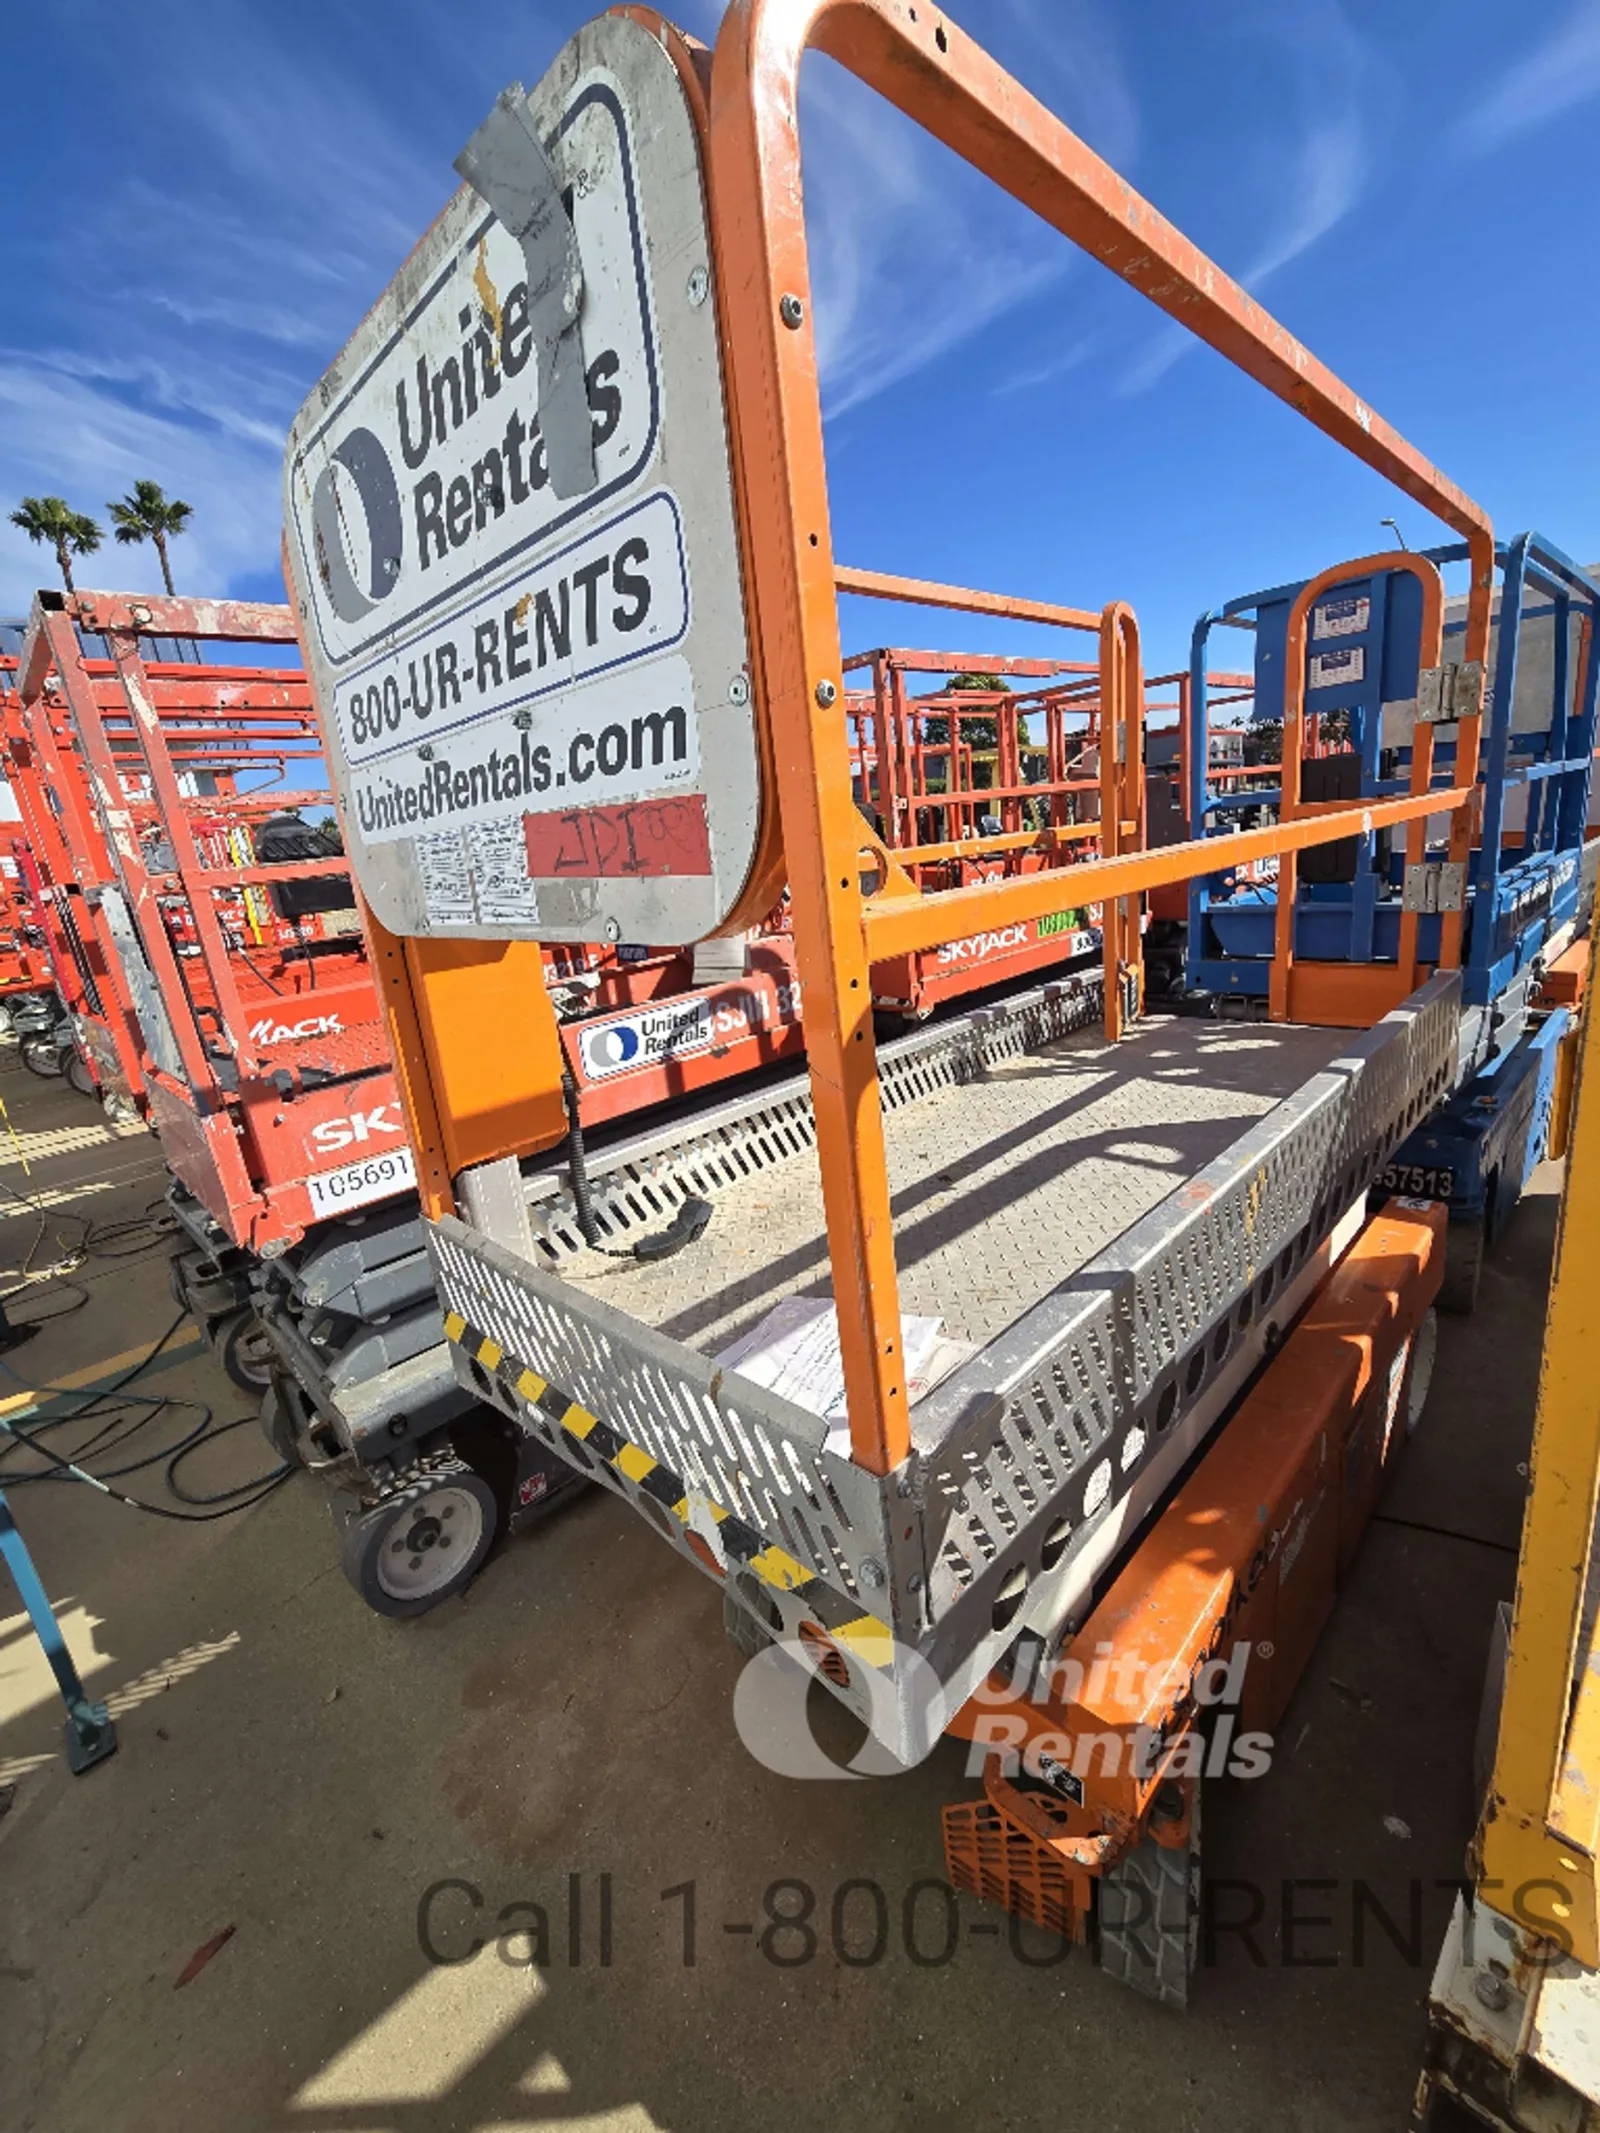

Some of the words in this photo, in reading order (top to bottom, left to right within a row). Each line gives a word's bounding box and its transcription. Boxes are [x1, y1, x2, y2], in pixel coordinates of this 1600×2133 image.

[395, 281, 531, 469] Unite
[414, 349, 622, 571] Rentas
[349, 536, 653, 746] 800-UR-RENTS
[356, 704, 688, 833] UnitedRentals.com
[937, 925, 1028, 964] SKYJACK
[641, 1006, 699, 1037] United
[644, 1025, 708, 1056] Rentals
[312, 1101, 403, 1152] SK
